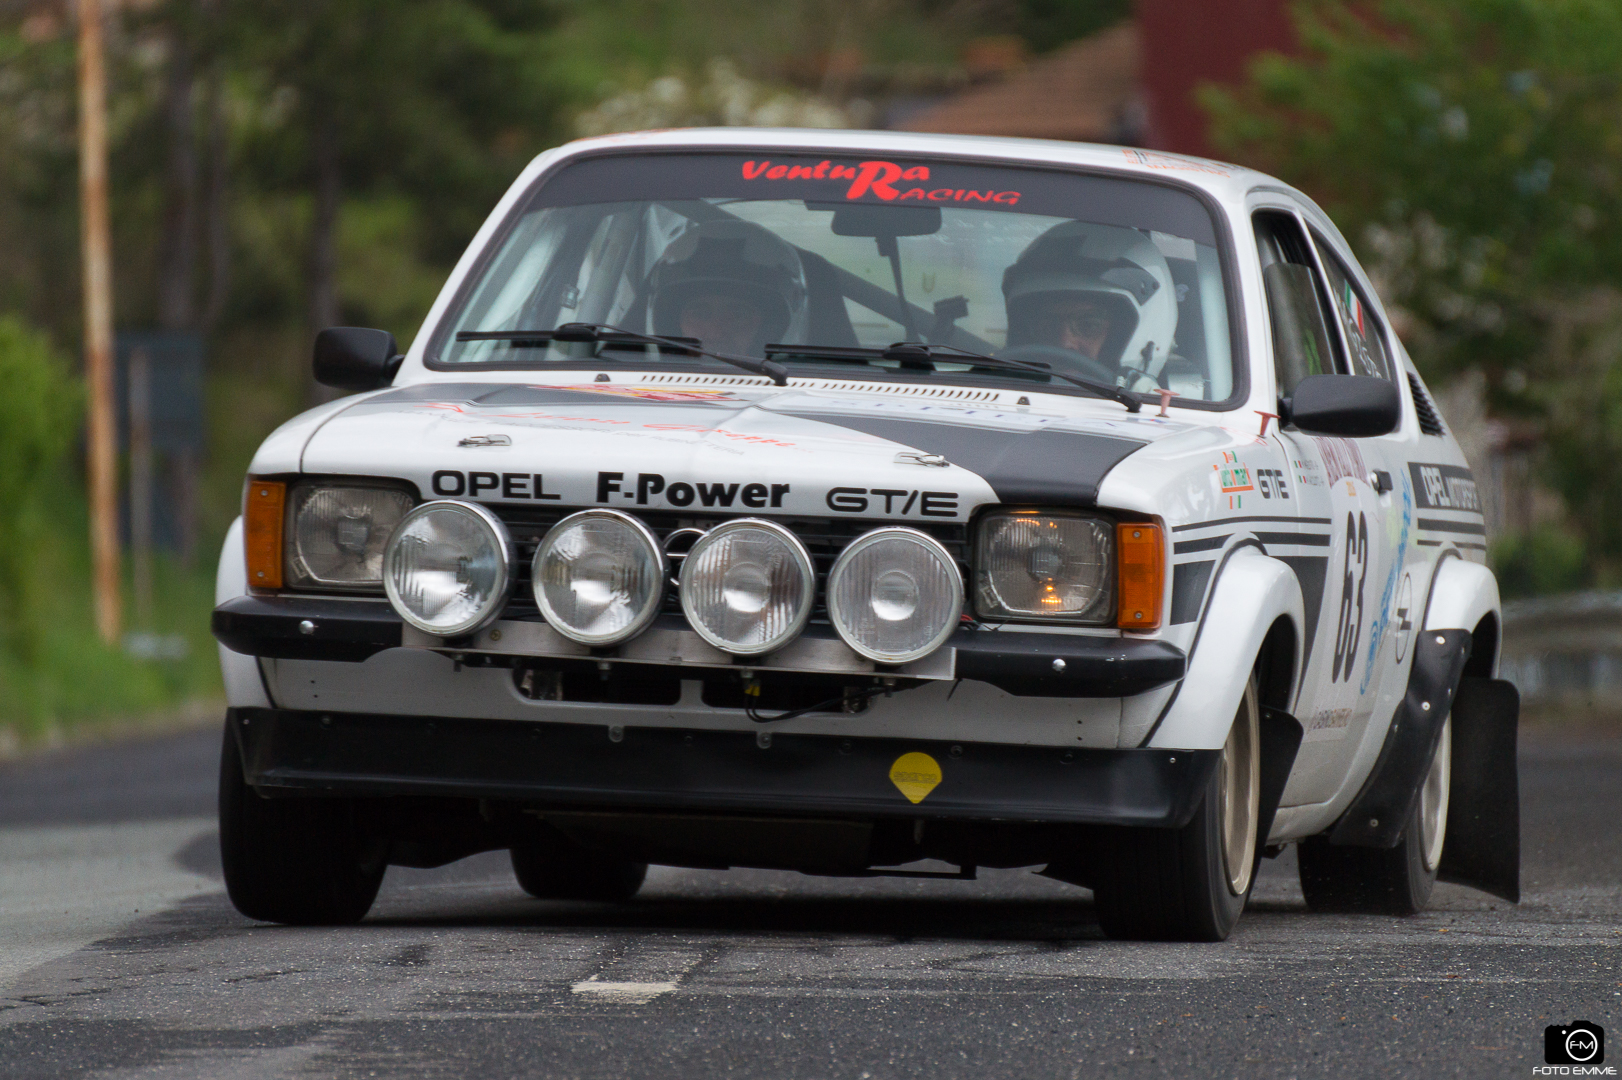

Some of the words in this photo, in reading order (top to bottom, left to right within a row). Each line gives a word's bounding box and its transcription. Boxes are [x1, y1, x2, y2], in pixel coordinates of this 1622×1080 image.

[432, 469, 561, 501] OPEL
[826, 486, 959, 518] GT/E
[1332, 510, 1369, 684] 63
